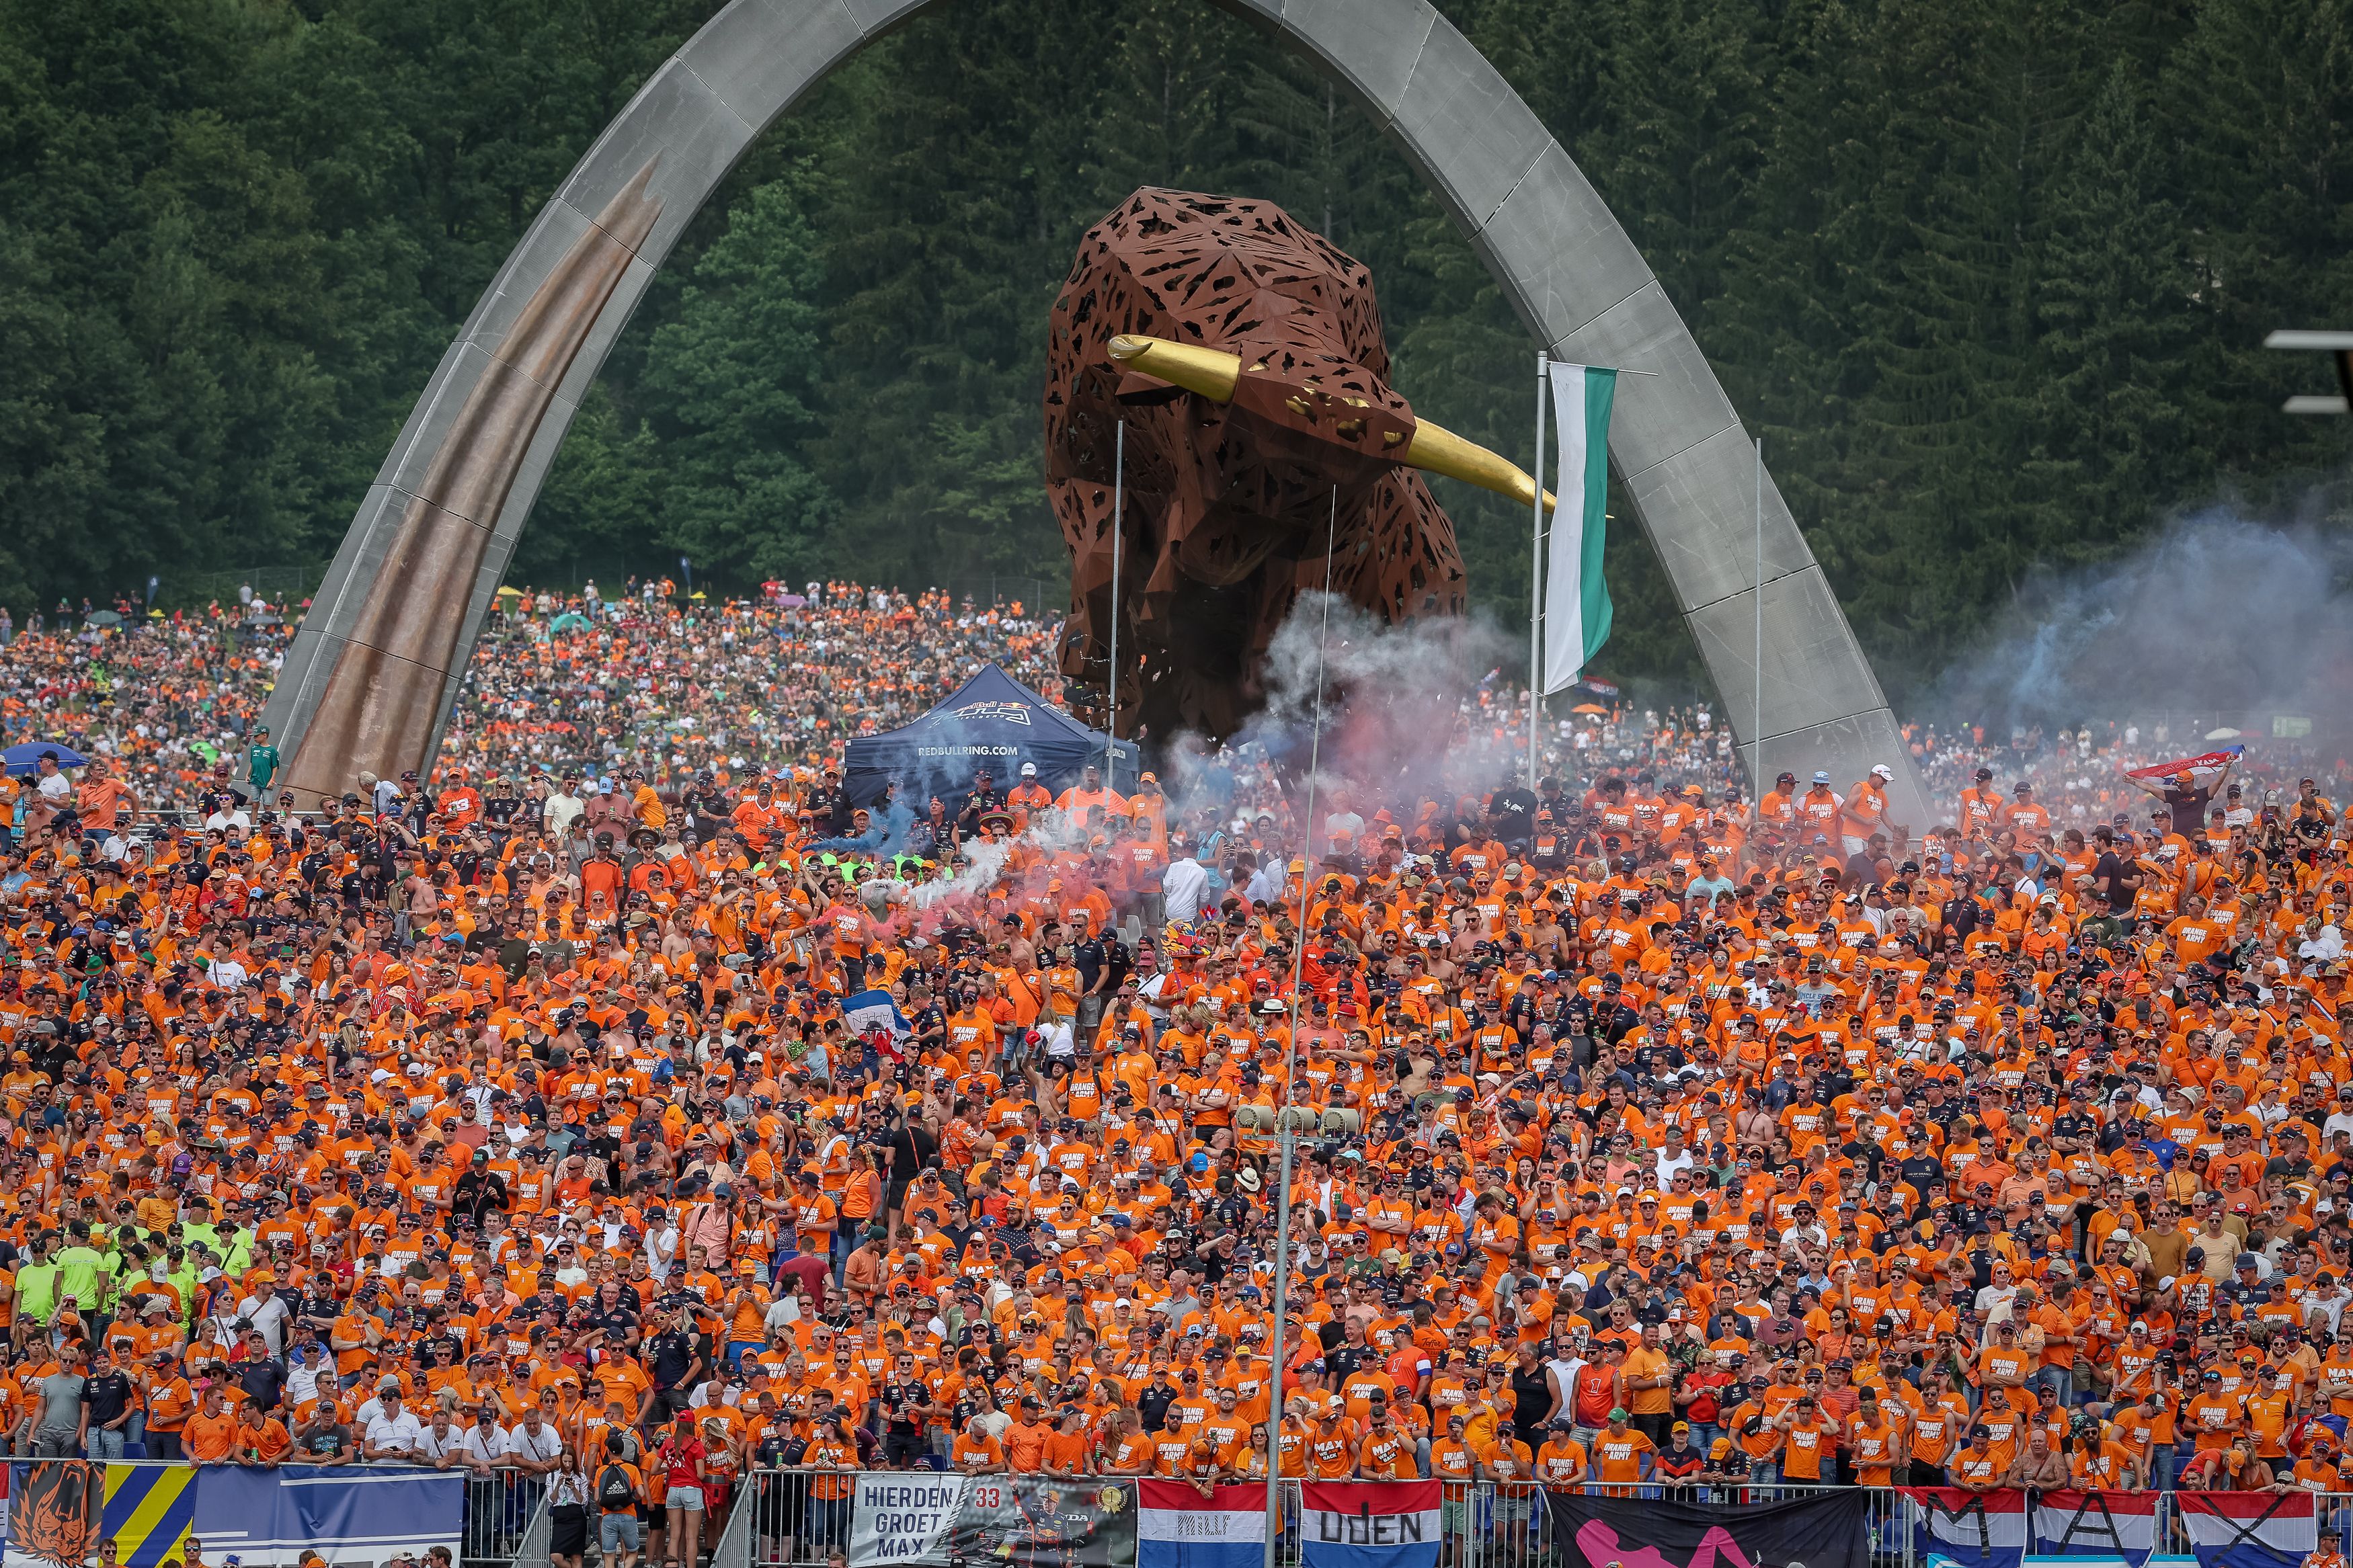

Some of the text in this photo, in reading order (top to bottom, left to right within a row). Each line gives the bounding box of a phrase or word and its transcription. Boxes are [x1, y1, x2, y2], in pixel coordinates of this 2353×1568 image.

[918, 747, 1018, 756] REDBULLRING.COM
[839, 922, 857, 930] ARMY
[1841, 932, 1866, 940] ORANGE
[2186, 934, 2205, 942] ARMY
[1798, 939, 1817, 947] ARMY
[957, 1033, 975, 1042] ARMY
[1845, 1050, 1868, 1058] ORANGE
[149, 1100, 172, 1108] ORANGE
[410, 1096, 433, 1104] ORANGE
[1793, 1116, 1817, 1124] ORANGE
[2171, 1128, 2198, 1137] ORANGE
[1060, 1154, 1084, 1162] ORANGE
[268, 1232, 292, 1241] ORANGE
[391, 1251, 418, 1259] ORANGE
[1853, 1298, 1875, 1306] ORANG
[1241, 1324, 1261, 1332] ORANG
[508, 1341, 528, 1349] RANGE
[1392, 1357, 1402, 1372] 1
[1991, 1359, 2018, 1368] ORANGE
[2122, 1356, 2149, 1365] MAX
[1996, 1368, 2016, 1376] ARMY
[1591, 1378, 1601, 1393] 1
[1183, 1408, 1204, 1416] RANGE
[2200, 1408, 2227, 1416] ORANGE
[1917, 1421, 1943, 1431] ORANGE
[1793, 1432, 1817, 1440] ORANGE
[1921, 1430, 1940, 1438] ARMY
[1990, 1432, 2009, 1440] ARMY
[1315, 1441, 1343, 1451] MAX
[1373, 1440, 1399, 1454] MAX
[1796, 1439, 1815, 1447] ARMY
[964, 1452, 988, 1461] ORANGE
[1381, 1454, 1396, 1462] BACK
[1443, 1452, 1464, 1461] ORANG
[1609, 1452, 1630, 1460] ARMY
[1548, 1458, 1574, 1467] ORANGE
[1554, 1467, 1570, 1475] ARMY
[865, 1486, 953, 1508] HIERDEN
[975, 1487, 1000, 1508] 33
[1109, 1491, 1114, 1503] 1
[875, 1513, 941, 1533] GROET
[1035, 1534, 1047, 1542] Red
[877, 1538, 924, 1557] MAX
